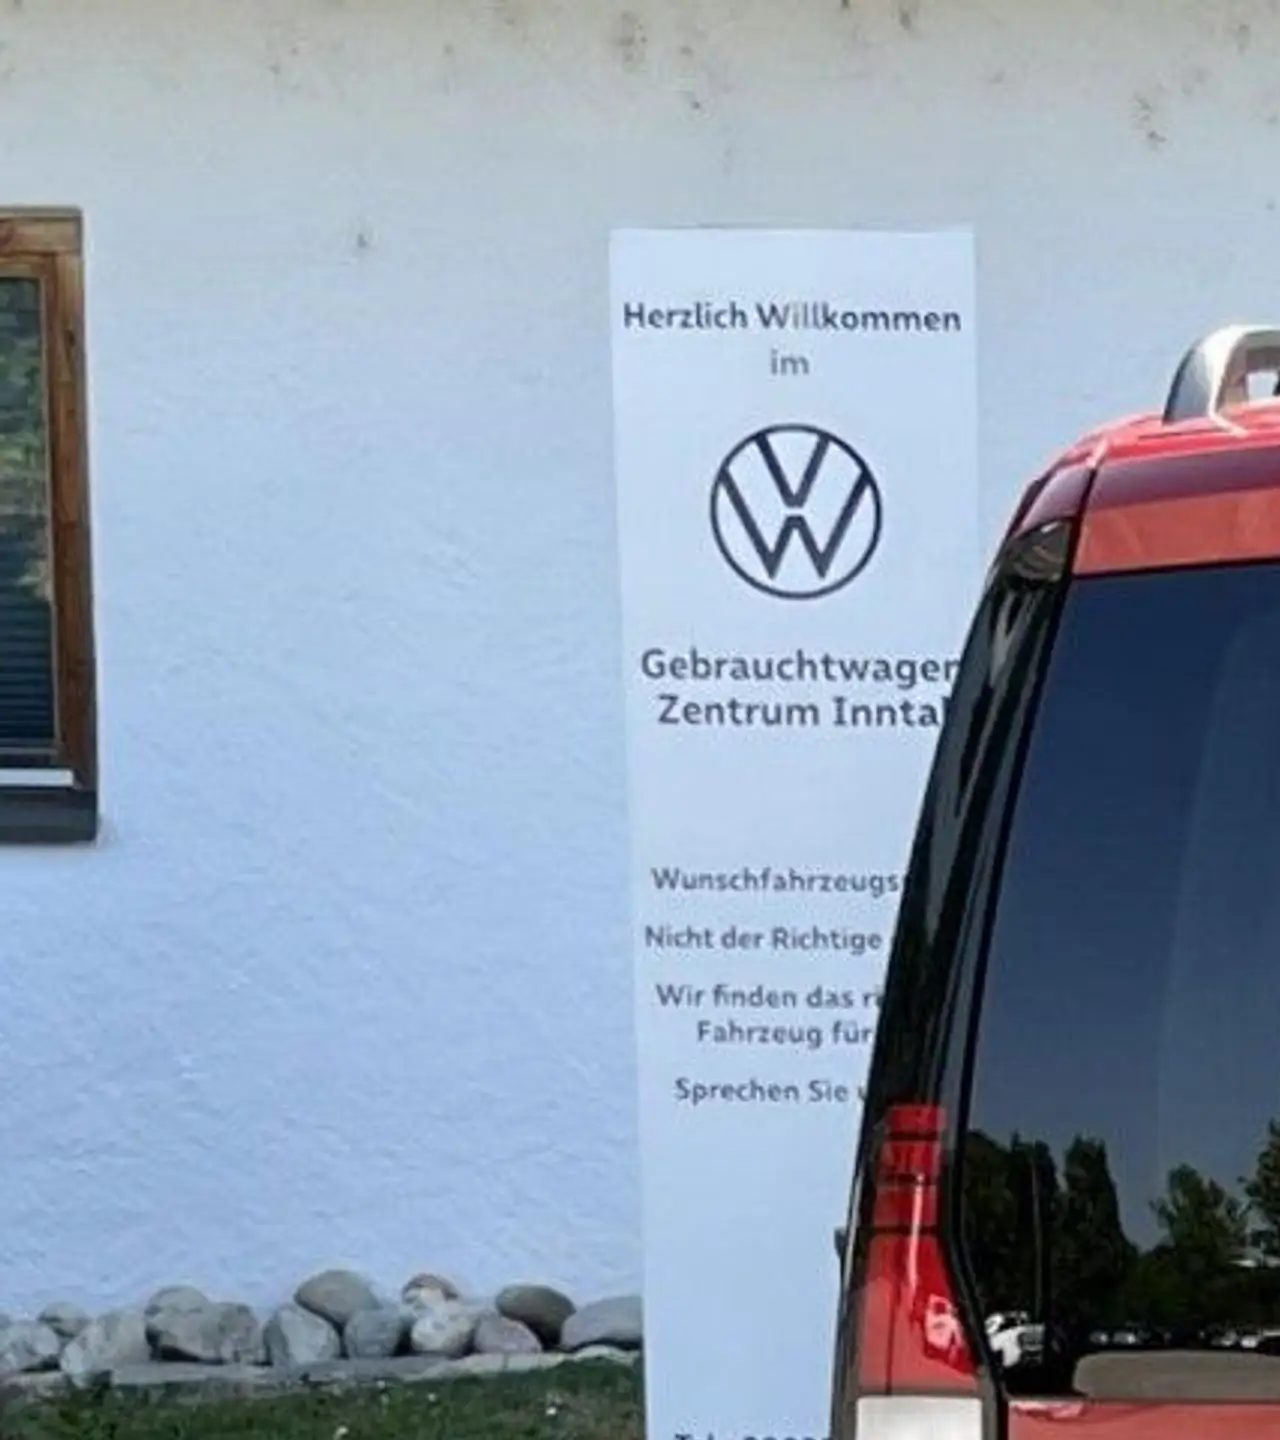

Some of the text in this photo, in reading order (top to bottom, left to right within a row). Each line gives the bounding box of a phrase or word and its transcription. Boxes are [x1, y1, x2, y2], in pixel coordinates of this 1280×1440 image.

[623, 301, 961, 332] Herzlich Willkommen
[769, 348, 811, 376] im
[709, 422, 883, 601] VW
[657, 694, 821, 726] Zentrum
[651, 866, 900, 899] Wunschfahrzeugs
[644, 924, 882, 956] Nicht der Richtige
[656, 983, 706, 1008] Wir
[712, 983, 797, 1009] finden
[805, 983, 855, 1010] das
[697, 1019, 872, 1050] Fahrzeug für
[674, 1076, 799, 1105] Sprechen
[807, 1079, 849, 1102] Sie
